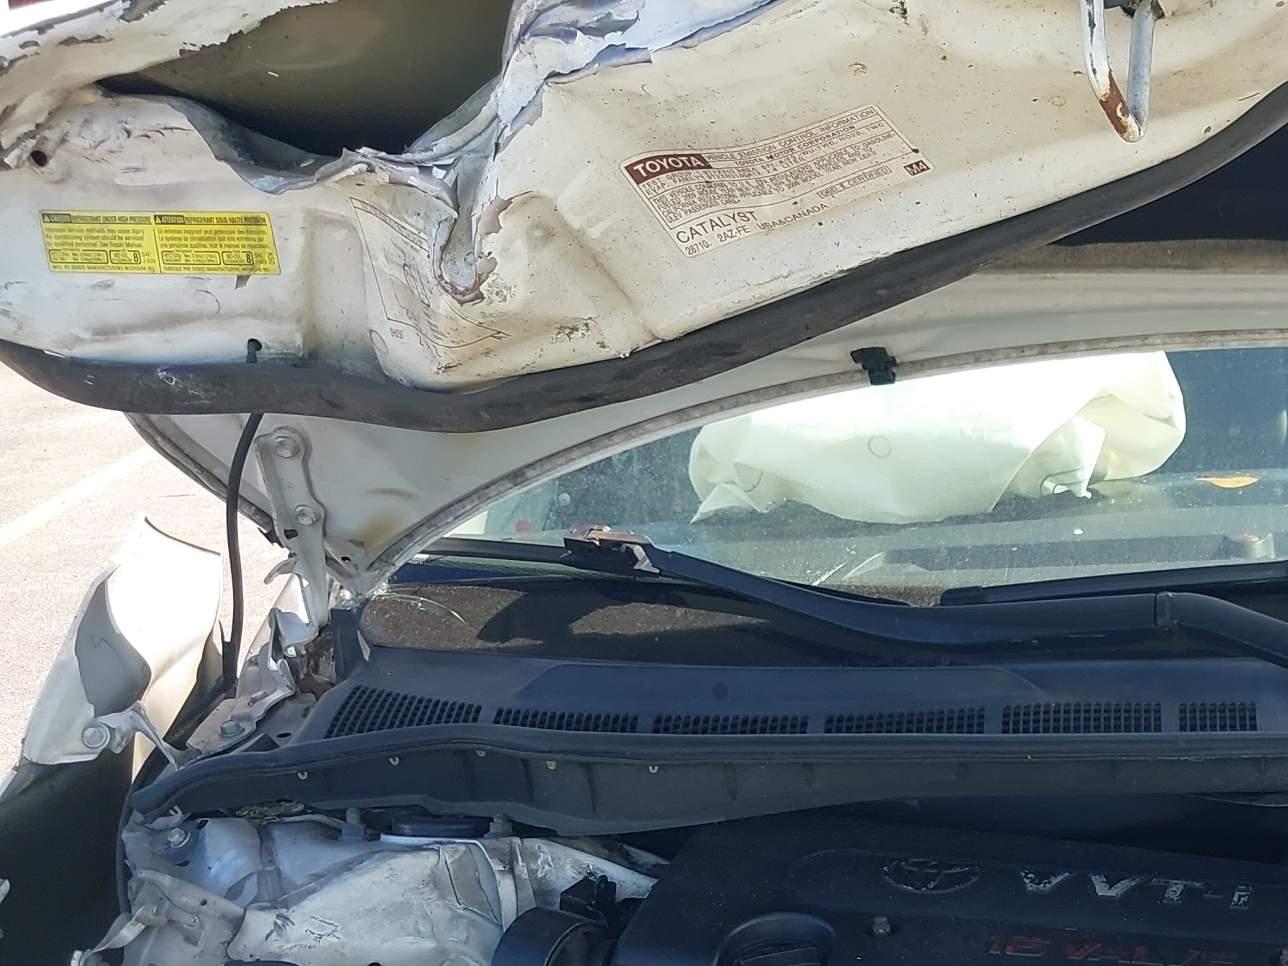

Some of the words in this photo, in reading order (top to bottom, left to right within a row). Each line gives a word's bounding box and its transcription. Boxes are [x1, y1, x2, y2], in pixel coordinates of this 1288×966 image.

[738, 143, 777, 158] EMISSION
[779, 130, 817, 147] CONTROL
[819, 109, 874, 133] INFORMATION
[766, 147, 795, 160] MOTOR
[797, 125, 856, 149] CORPORATION
[633, 156, 705, 177] TOYOTA
[846, 166, 889, 187] CERTIFIED
[906, 161, 927, 176] M4
[676, 210, 759, 244] CATALYST
[717, 225, 751, 243] 2AZ-FE
[756, 203, 830, 231] USA&CANADA
